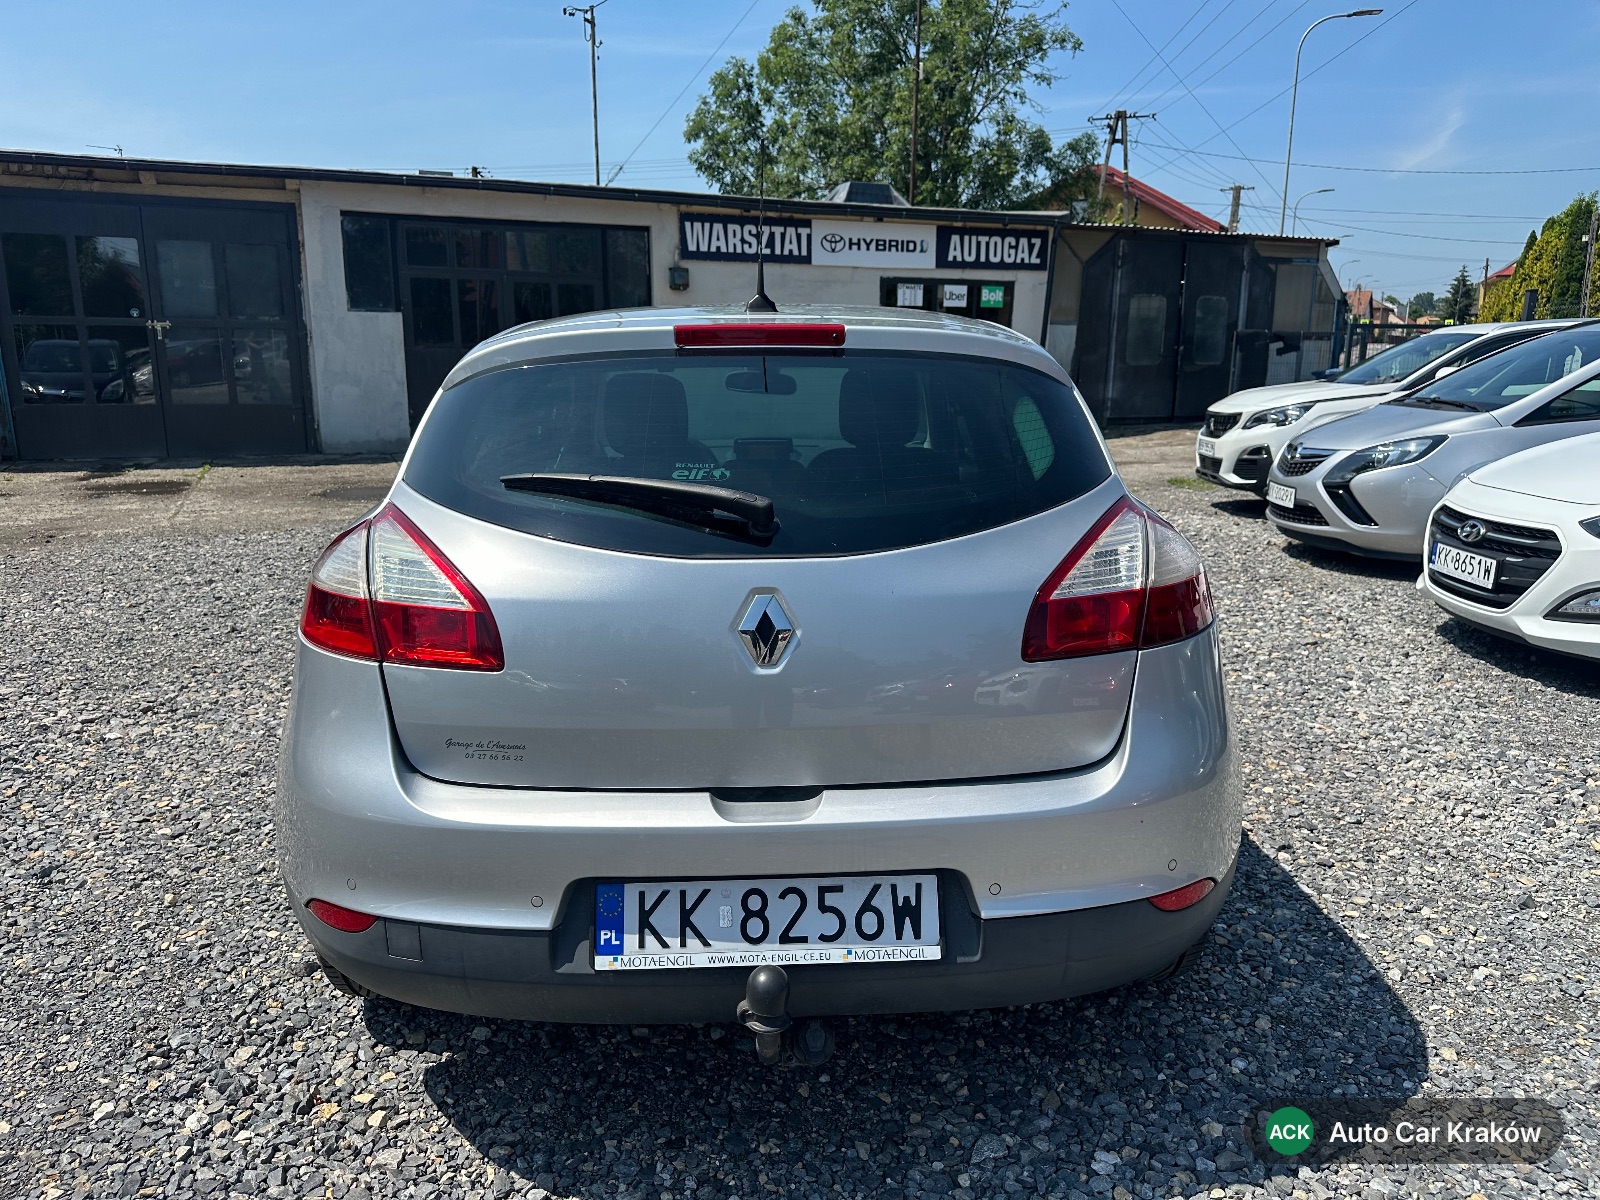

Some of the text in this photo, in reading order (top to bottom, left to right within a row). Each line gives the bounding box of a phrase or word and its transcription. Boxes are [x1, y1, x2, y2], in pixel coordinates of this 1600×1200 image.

[684, 220, 810, 257] WARSZTAT
[848, 237, 917, 253] HYBRID
[947, 233, 1041, 265] AUTOGAZ
[944, 291, 966, 302] Uber
[981, 289, 1003, 302] Bolt
[1453, 551, 1493, 581] 8651W
[445, 738, 473, 750] Garage
[475, 741, 485, 749] de
[489, 753, 499, 761] 66
[637, 882, 922, 949] KK 8256W
[599, 929, 620, 946] PL
